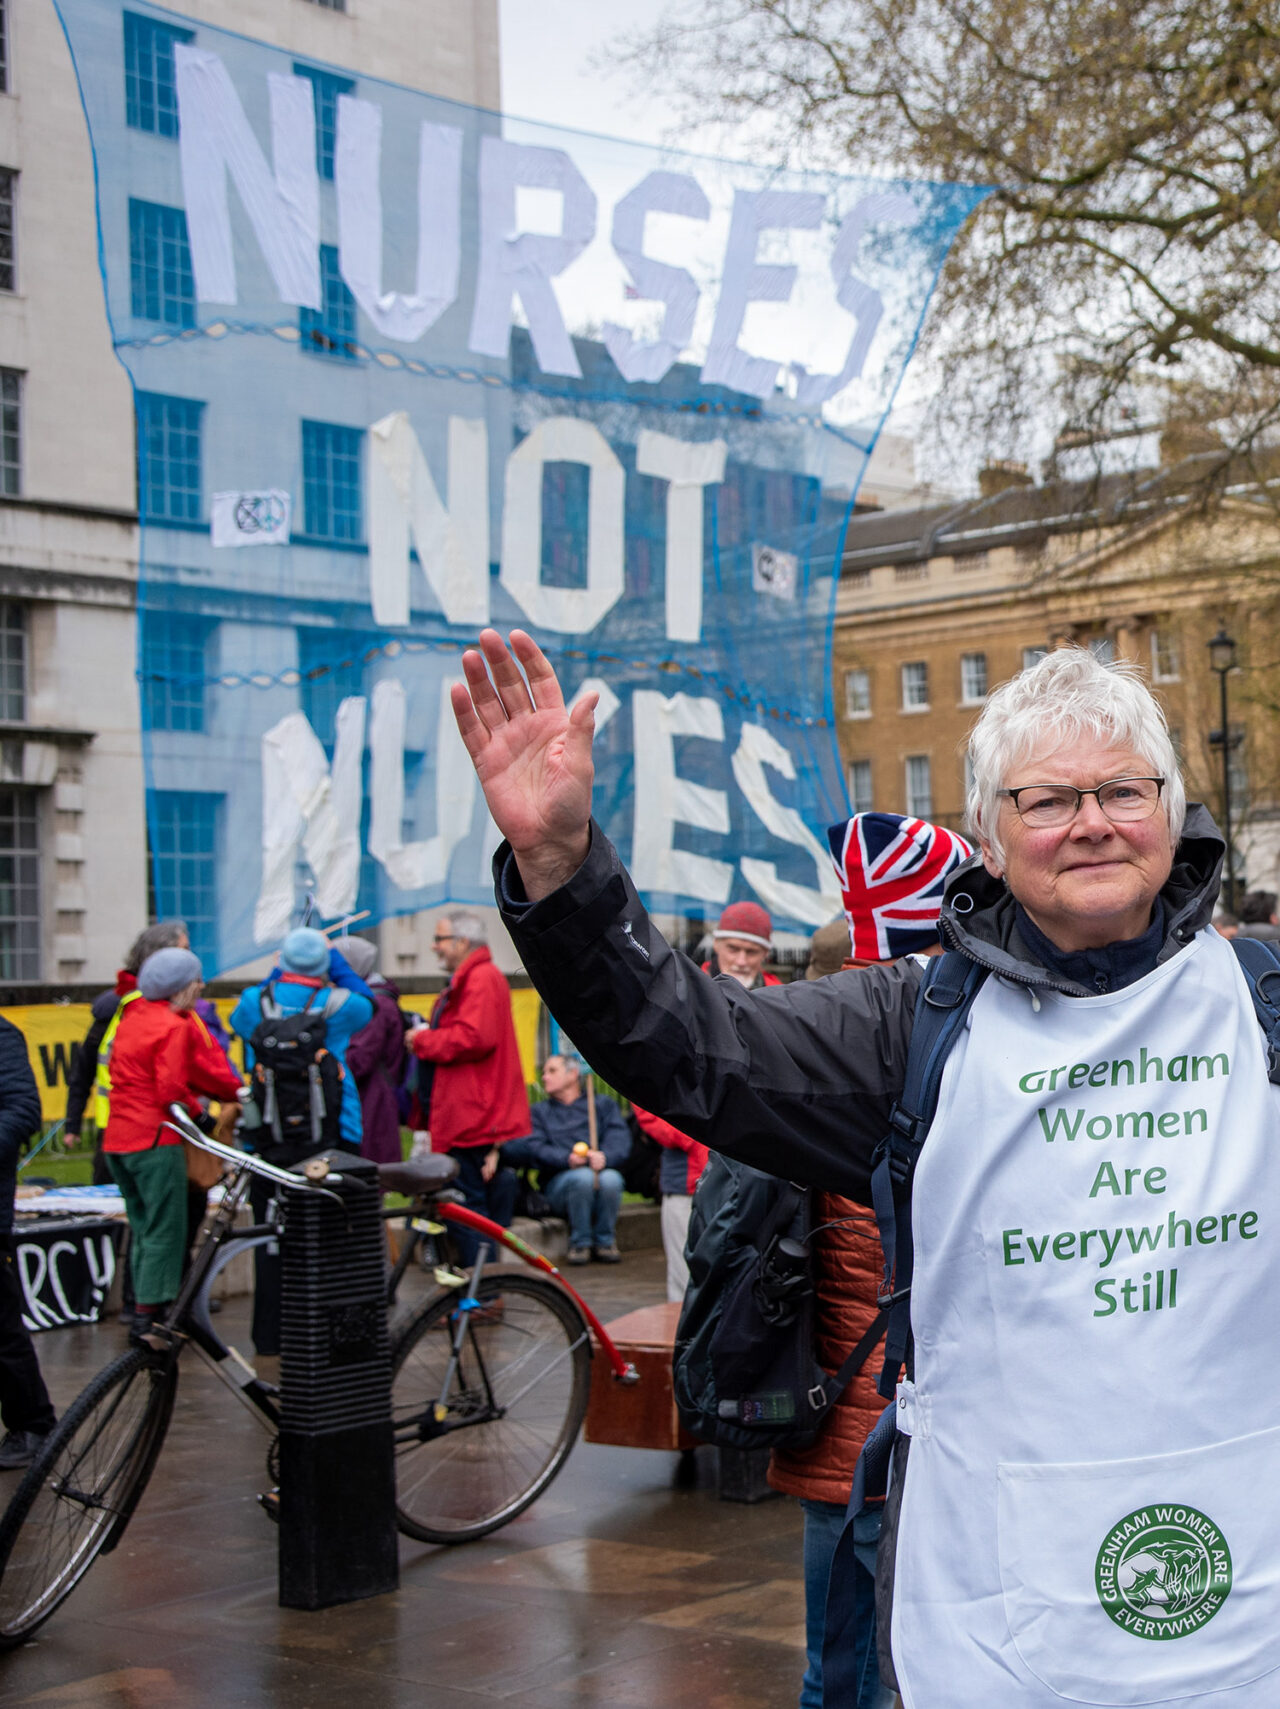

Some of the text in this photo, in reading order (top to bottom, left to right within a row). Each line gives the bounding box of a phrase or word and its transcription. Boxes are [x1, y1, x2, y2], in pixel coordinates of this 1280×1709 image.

[174, 43, 918, 400] NURSES
[369, 411, 727, 642] NOT
[1018, 1047, 1230, 1093] Greenham
[1038, 1108, 1208, 1142] Women
[1088, 1161, 1167, 1198] Are
[1002, 1210, 1258, 1268] Everywhere
[1093, 1268, 1178, 1317] Still
[1100, 1508, 1228, 1602] GREENHAM WOMEN ARE
[1114, 1593, 1222, 1636] EVERYWHERE
